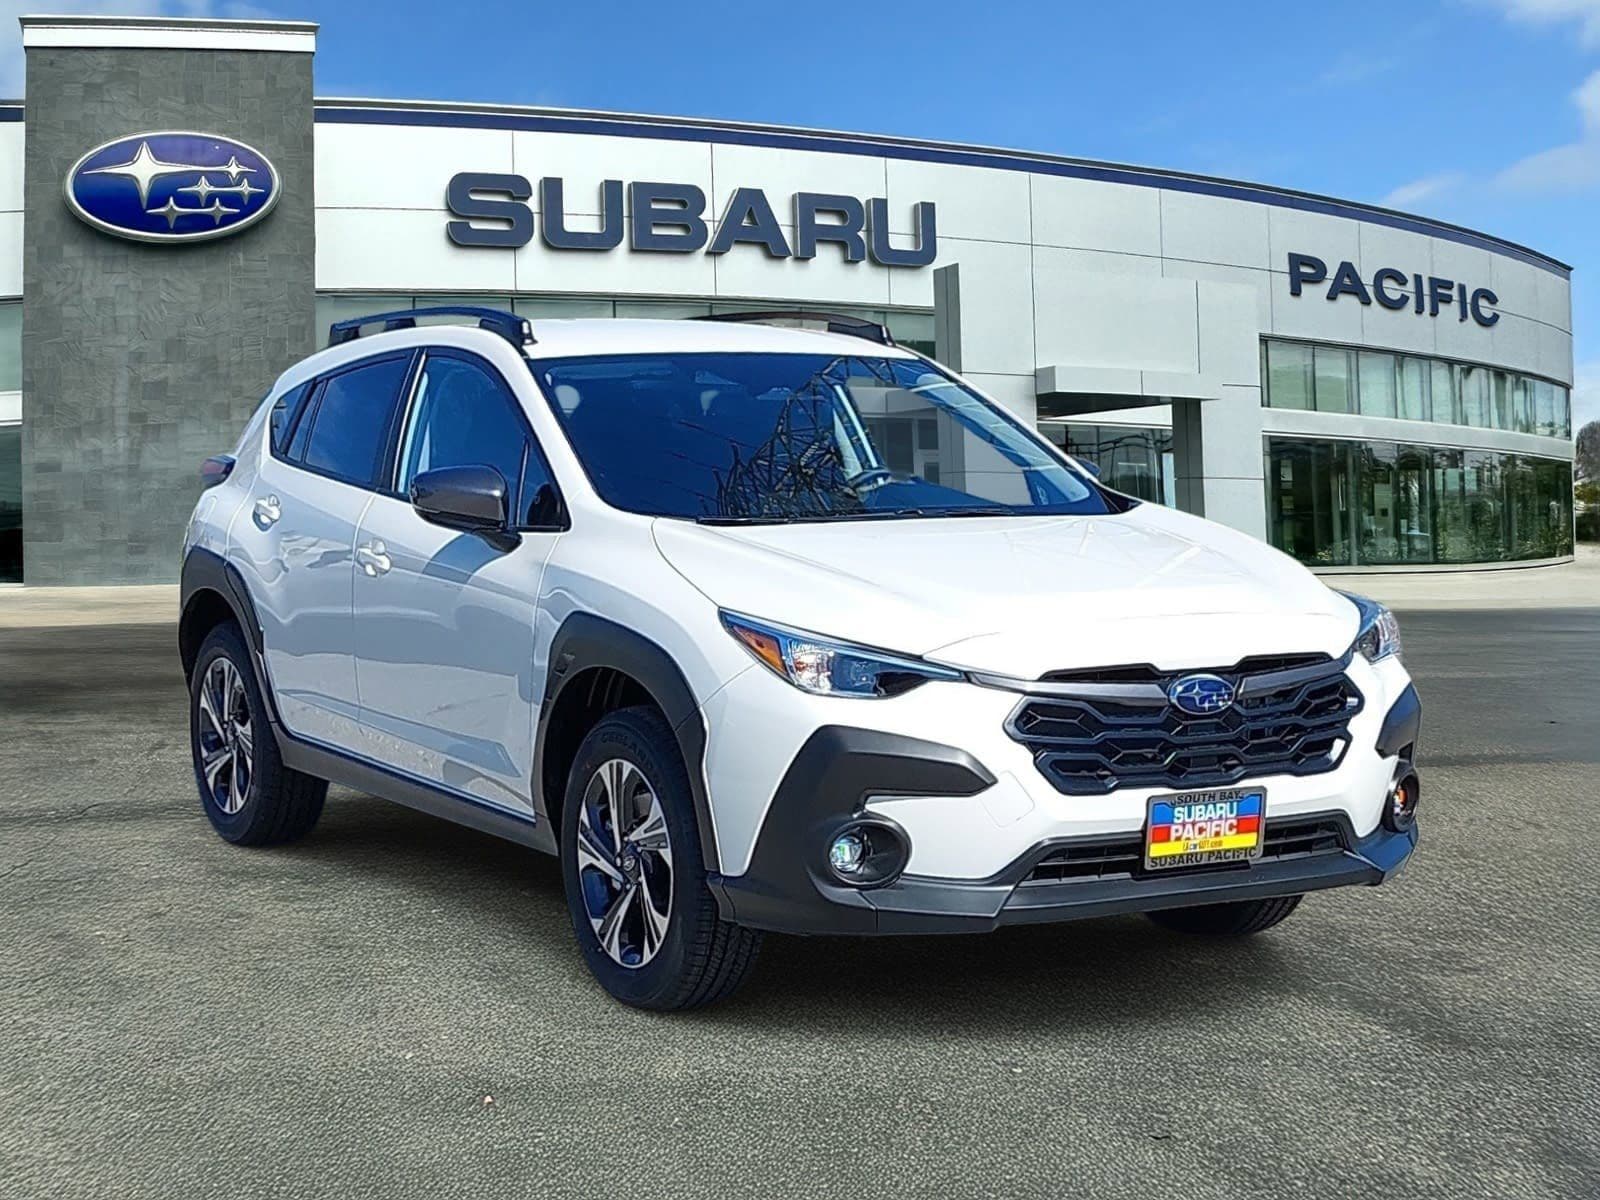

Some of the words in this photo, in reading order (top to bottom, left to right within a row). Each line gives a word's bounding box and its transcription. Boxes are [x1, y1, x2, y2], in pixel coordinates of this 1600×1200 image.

[446, 171, 937, 267] SUBARU
[1288, 252, 1500, 327] PACIFIC
[1176, 792, 1216, 806] SOUTH
[1220, 790, 1241, 801] BAY
[1173, 801, 1238, 824] SUBARU
[1170, 819, 1238, 842] PACIFIC
[1150, 853, 1203, 868] SUBARU
[1207, 847, 1257, 862] PACIFIC
